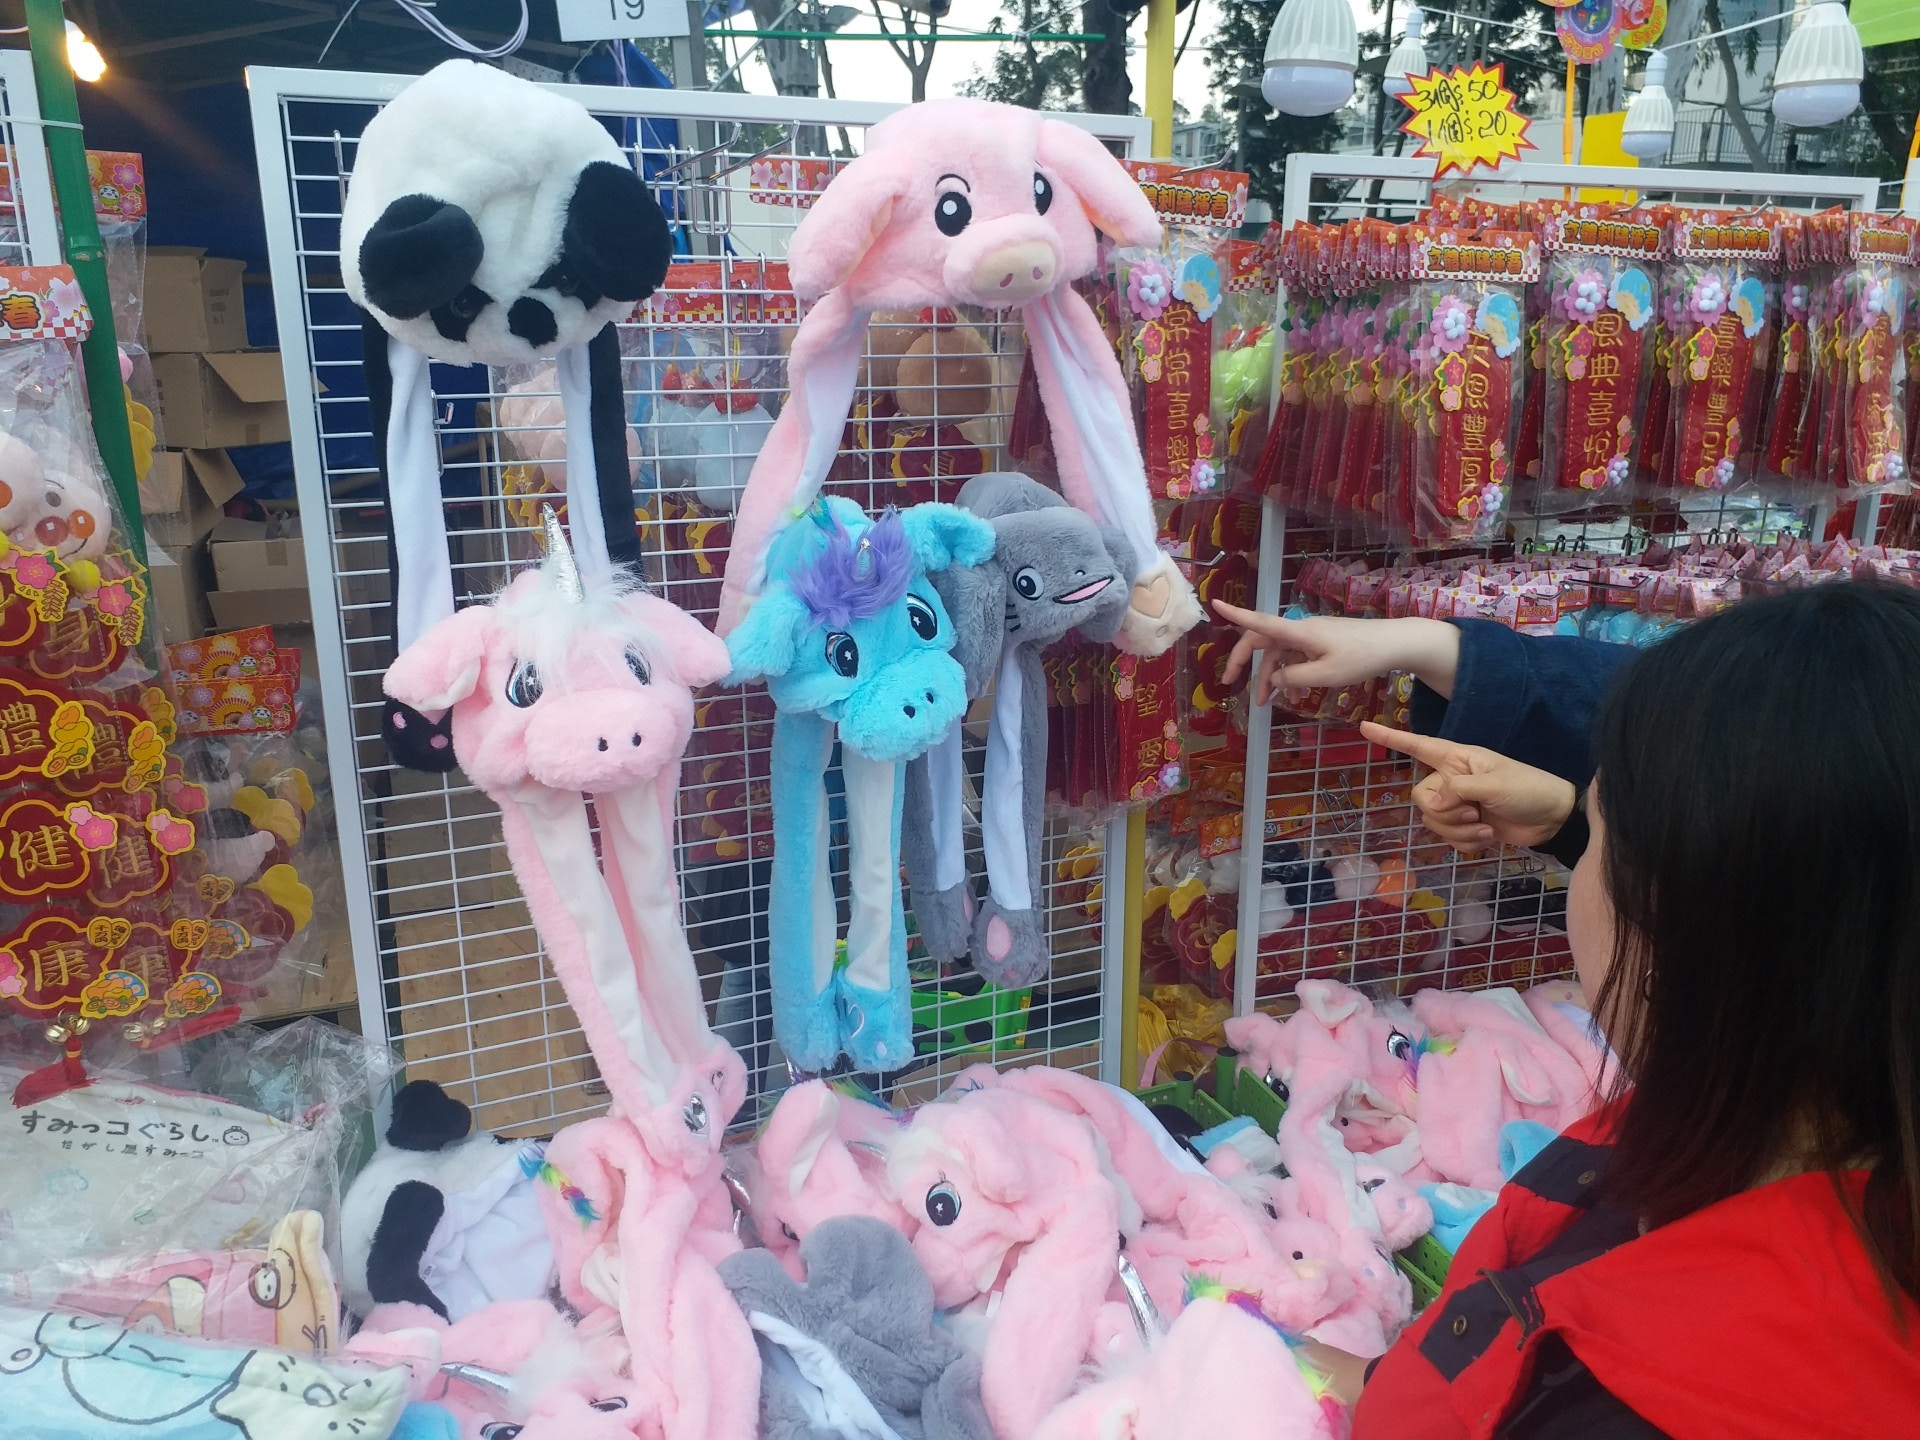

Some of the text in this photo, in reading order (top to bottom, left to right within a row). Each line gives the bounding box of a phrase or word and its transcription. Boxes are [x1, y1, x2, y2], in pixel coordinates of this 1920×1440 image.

[21, 1110, 209, 1143] すみっコぐらし
